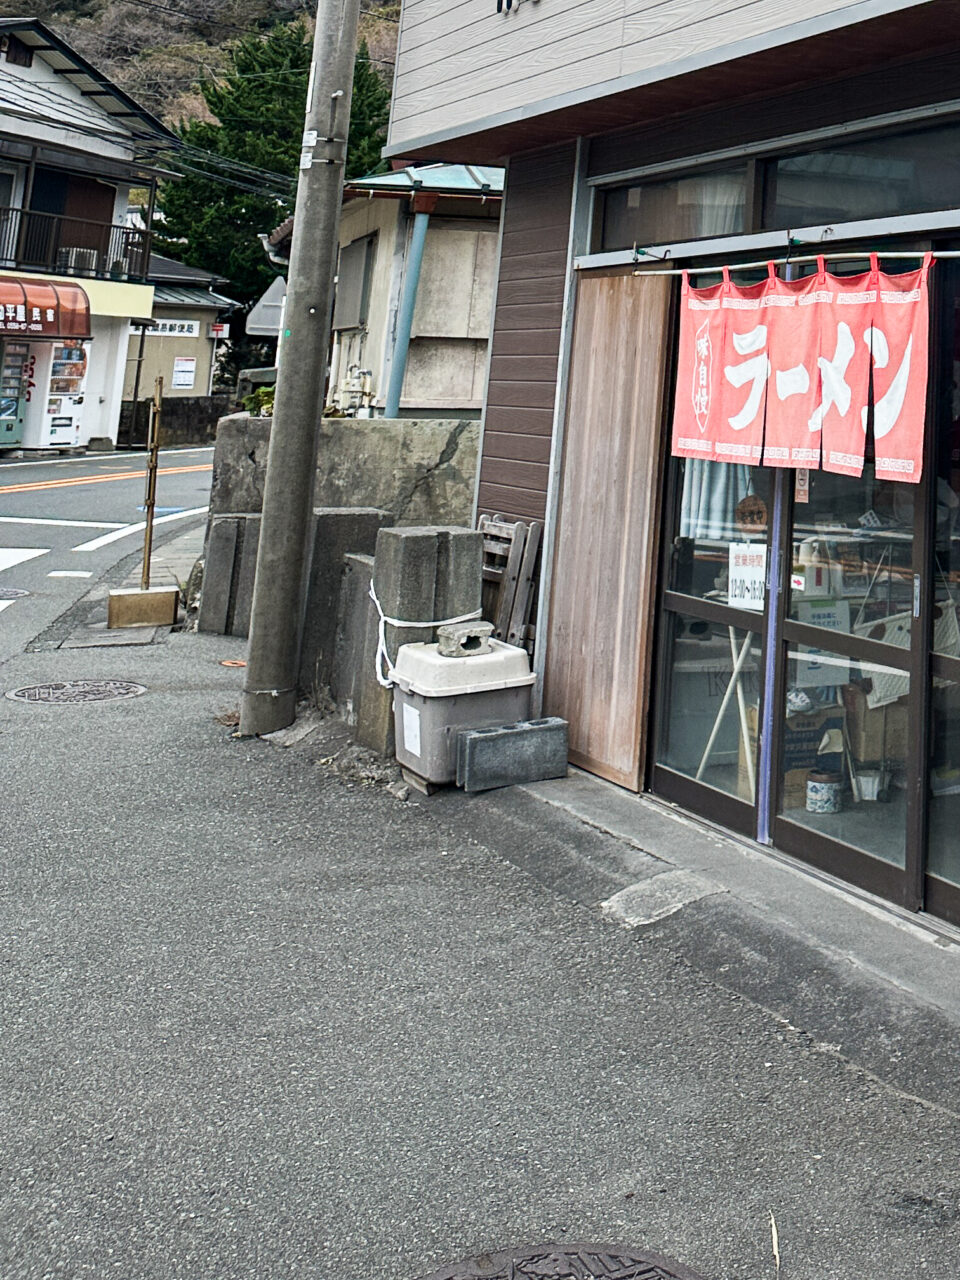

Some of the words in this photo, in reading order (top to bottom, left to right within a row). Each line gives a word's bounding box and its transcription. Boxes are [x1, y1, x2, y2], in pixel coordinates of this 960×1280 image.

[695, 334, 710, 415] 味自慢
[724, 320, 913, 440] ラーメン
[734, 553, 763, 568] 営業時間
